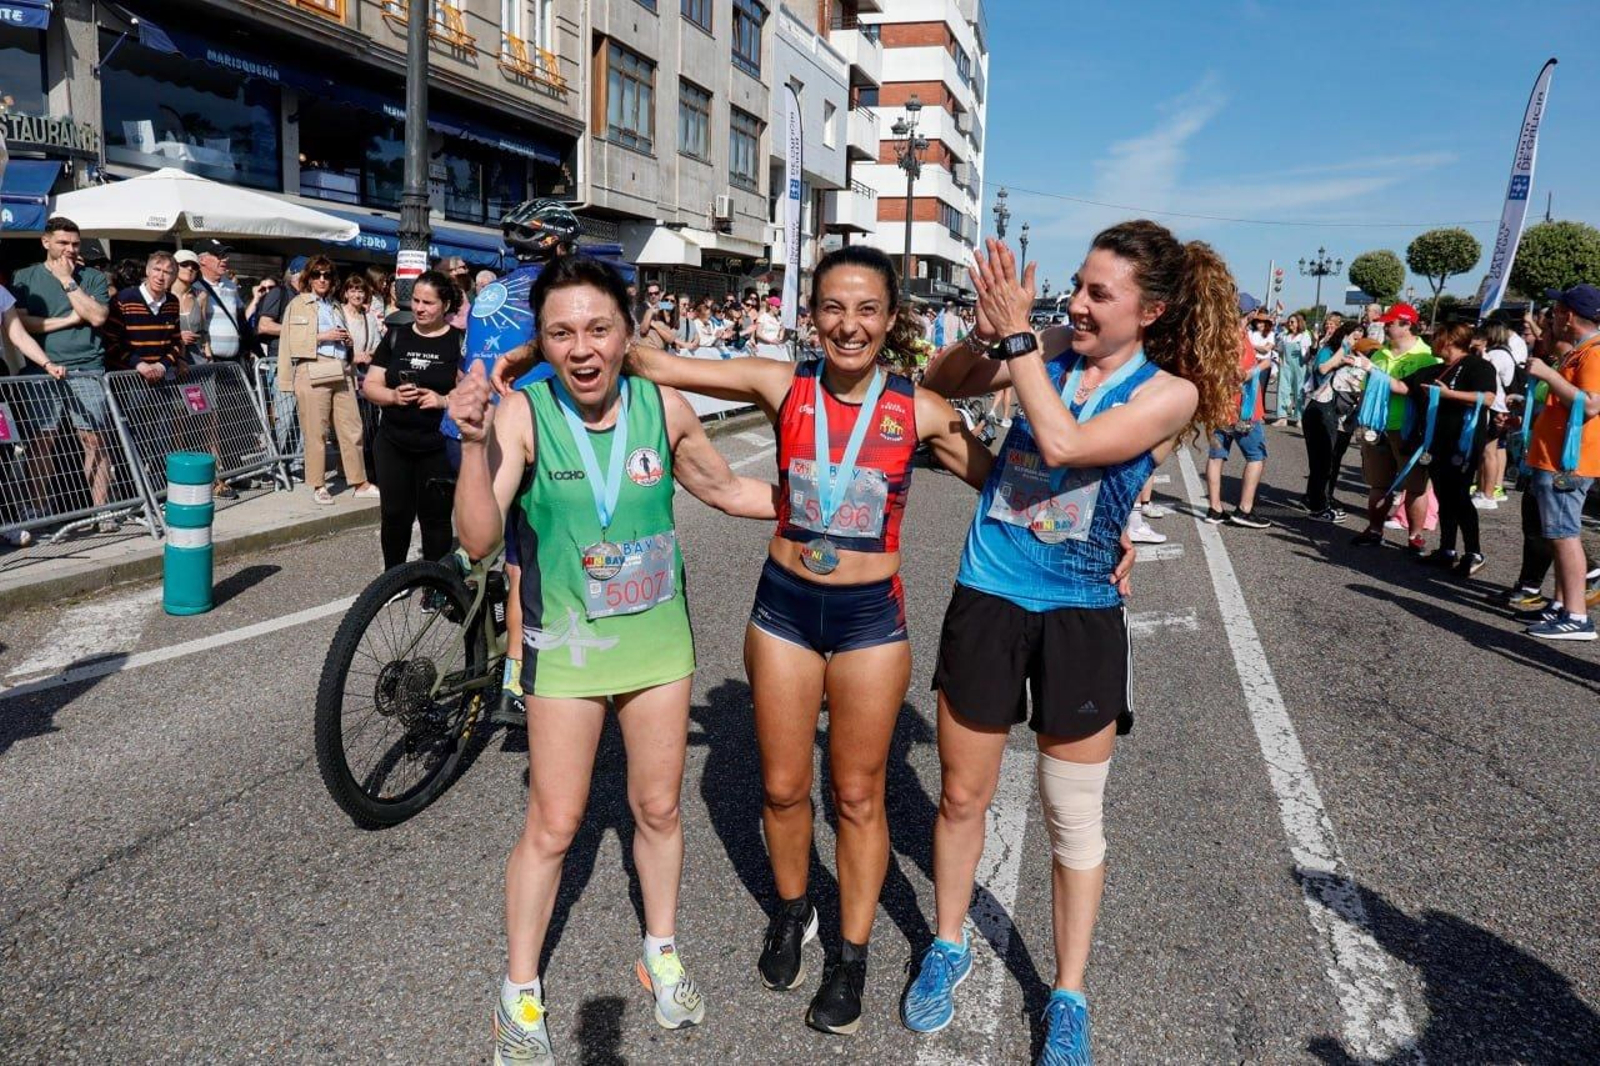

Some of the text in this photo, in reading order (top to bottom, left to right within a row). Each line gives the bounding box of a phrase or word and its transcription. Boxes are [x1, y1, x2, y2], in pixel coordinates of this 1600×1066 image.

[355, 235, 387, 250] PEDRO
[805, 500, 870, 529] 596
[606, 570, 665, 607] 5007
